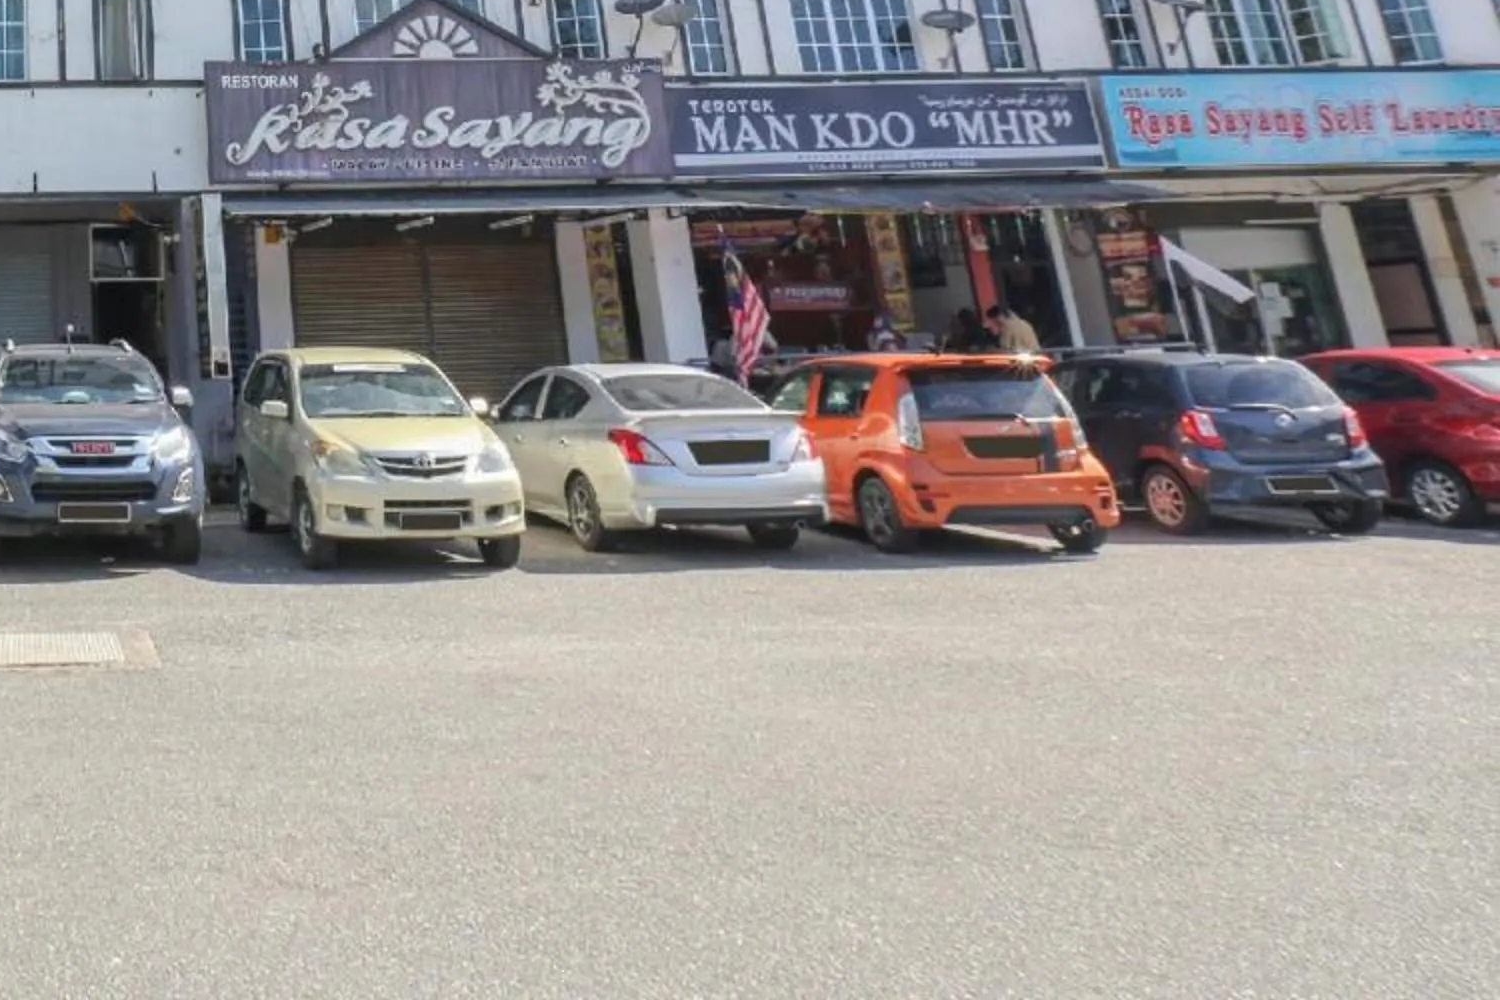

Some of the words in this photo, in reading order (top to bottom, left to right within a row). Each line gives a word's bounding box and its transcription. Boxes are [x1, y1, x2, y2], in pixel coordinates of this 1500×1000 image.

[221, 74, 299, 90] RESTORAN
[226, 103, 409, 165] Rasa
[413, 106, 649, 167] Sayang
[690, 114, 799, 152] MAN
[810, 111, 915, 149] KDO
[1122, 104, 1193, 148] Rasa
[1205, 104, 1310, 144] Sayang
[1316, 101, 1376, 135] Self
